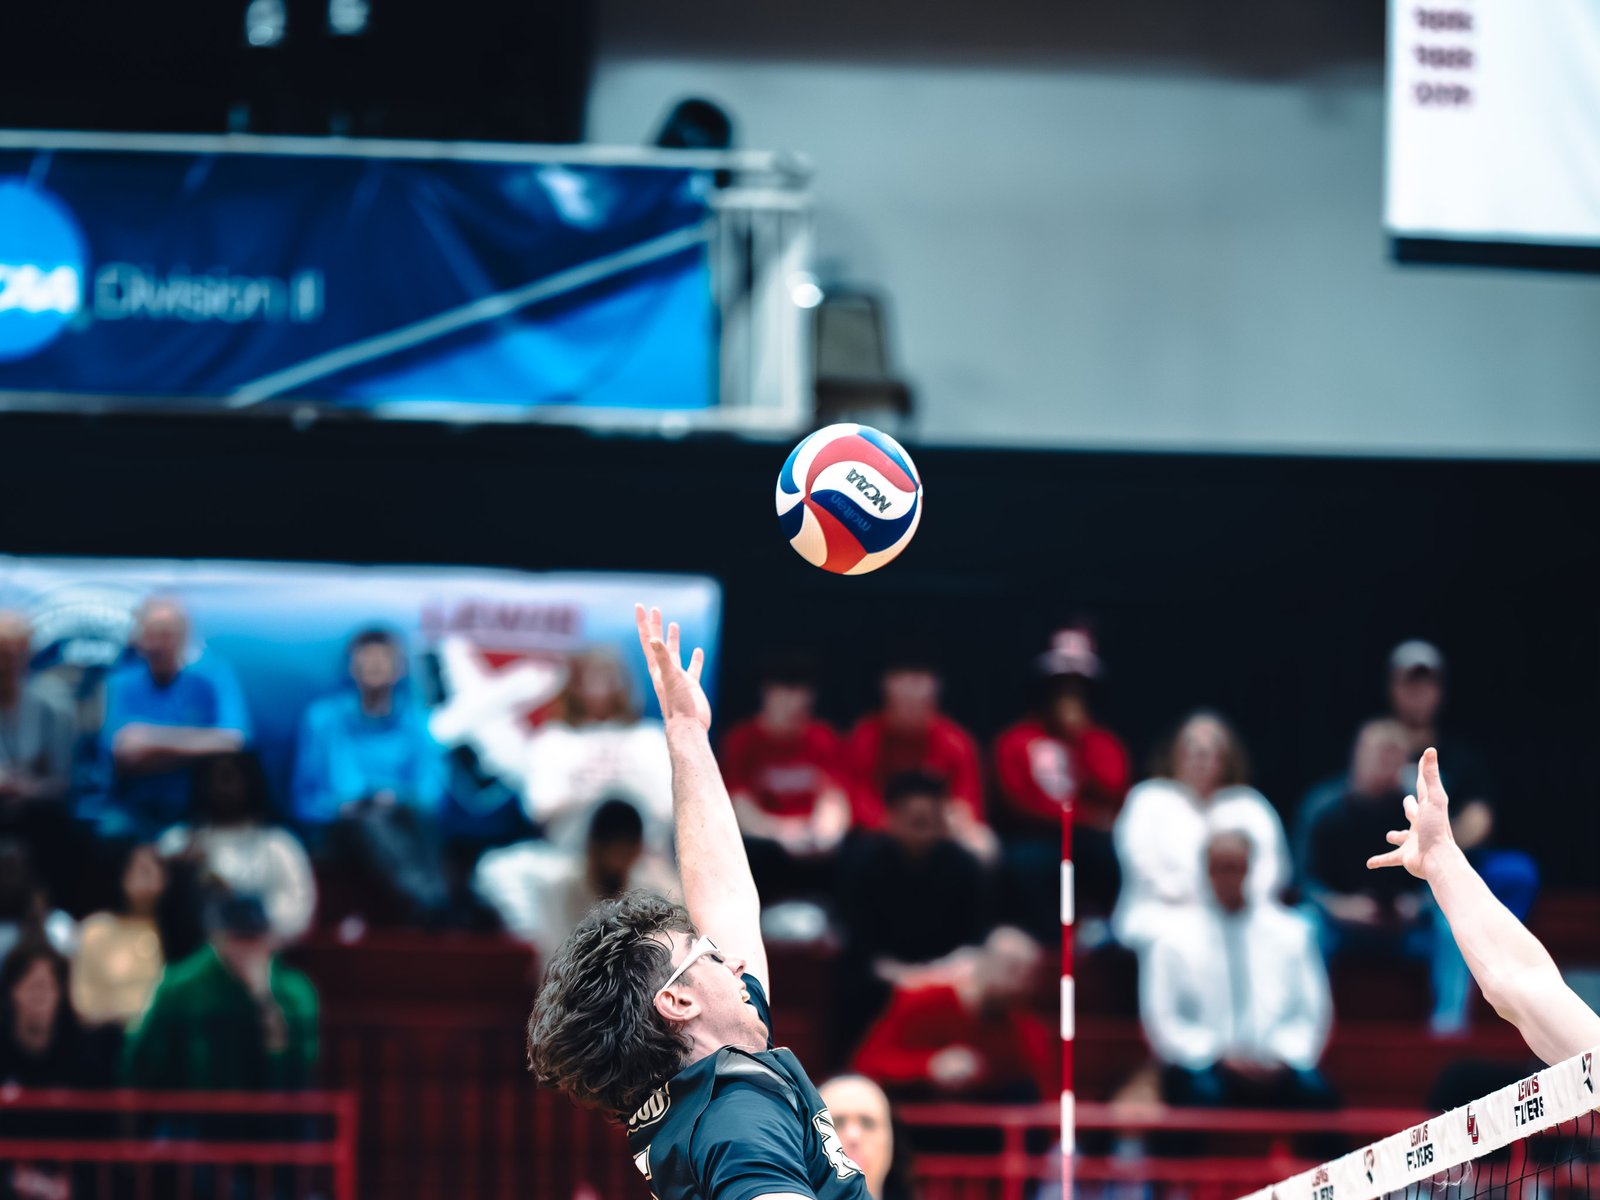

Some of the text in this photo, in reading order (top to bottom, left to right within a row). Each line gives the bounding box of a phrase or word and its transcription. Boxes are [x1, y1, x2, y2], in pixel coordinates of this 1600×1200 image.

[95, 262, 288, 322] Division
[845, 467, 892, 514] NCAA
[831, 493, 872, 532] molten
[1517, 1075, 1540, 1102] LEWIS
